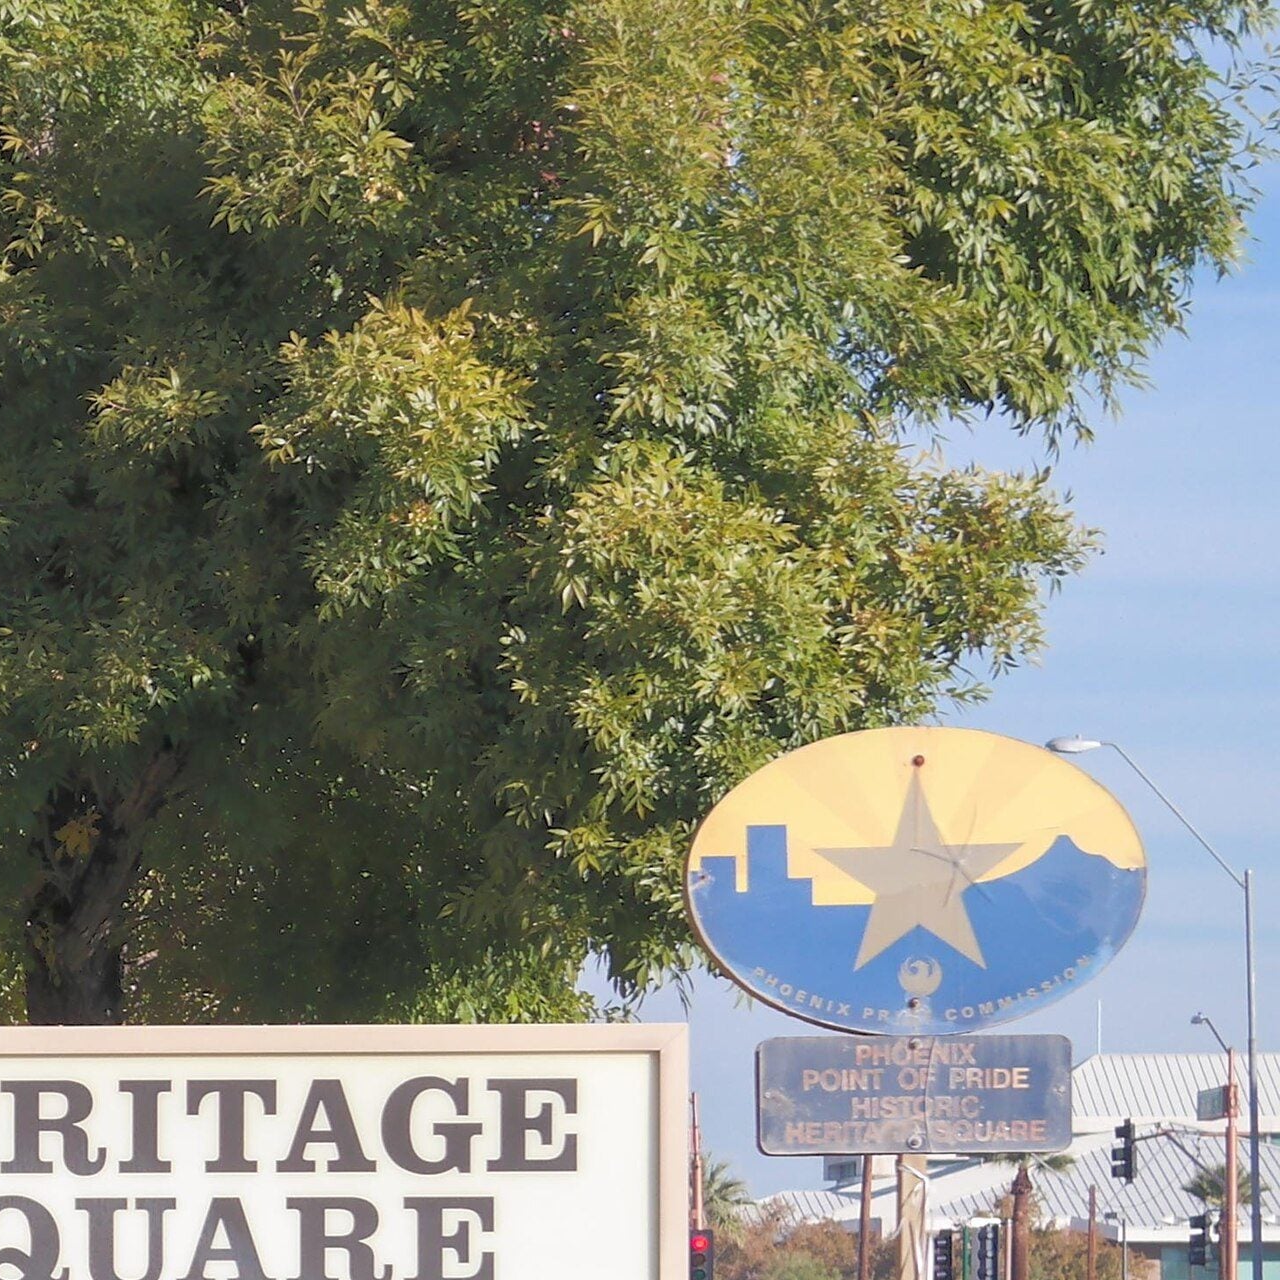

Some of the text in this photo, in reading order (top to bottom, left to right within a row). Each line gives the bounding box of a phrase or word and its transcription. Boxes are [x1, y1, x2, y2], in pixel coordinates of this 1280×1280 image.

[753, 955, 1090, 1021] PHOENIX COMMISSION
[855, 1043, 976, 1066] PHOENIX
[802, 1067, 1031, 1091] POINT OF PRIDE
[851, 1096, 980, 1119] HISTORIC
[933, 1119, 1048, 1142] SQUARE
